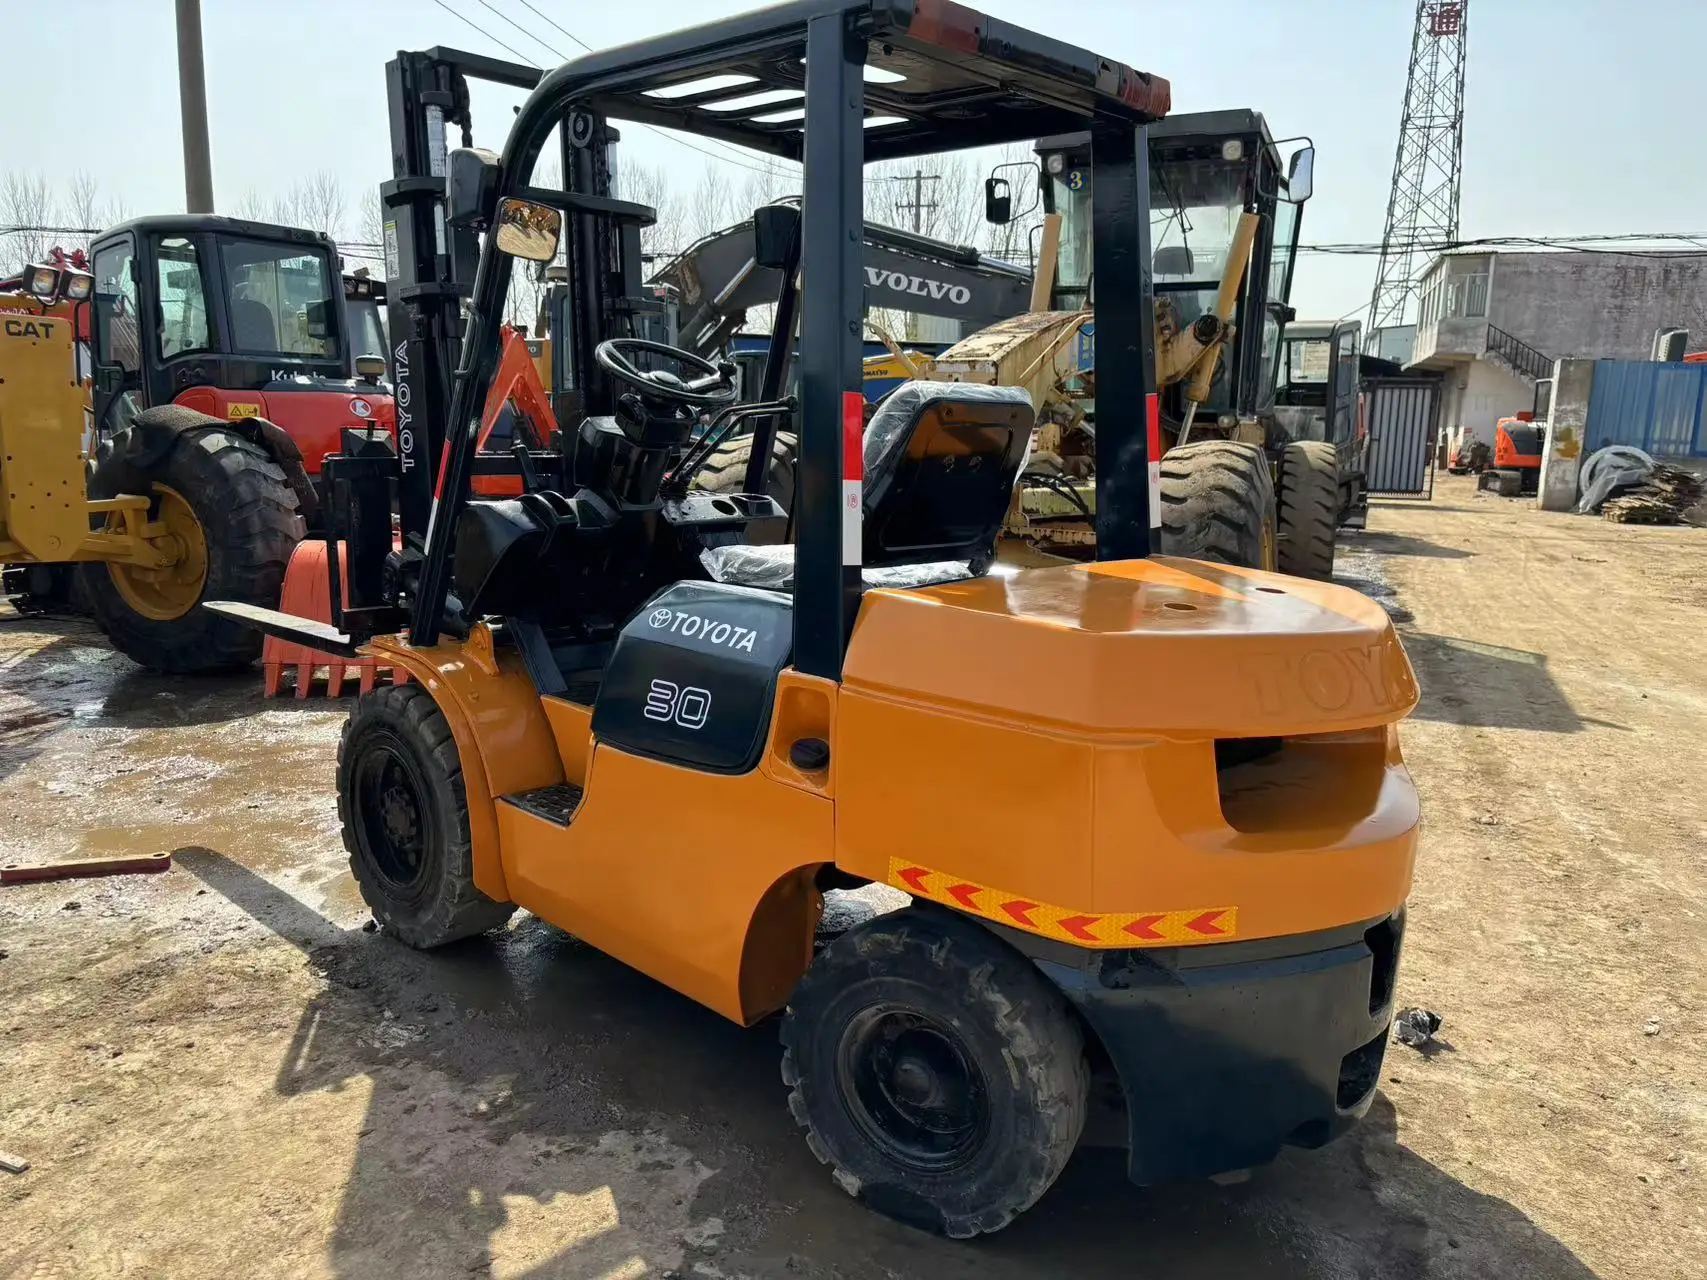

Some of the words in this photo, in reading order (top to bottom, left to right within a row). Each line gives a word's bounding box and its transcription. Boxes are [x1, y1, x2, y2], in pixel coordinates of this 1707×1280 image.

[1427, 5, 1461, 36] 通
[1070, 171, 1083, 190] 3
[863, 266, 971, 304] VOLVO
[5, 320, 54, 339] CAT
[395, 339, 415, 473] TOYOTA
[670, 611, 757, 652] TOYOTA
[1237, 644, 1387, 717] TOY
[644, 678, 711, 730] 30
